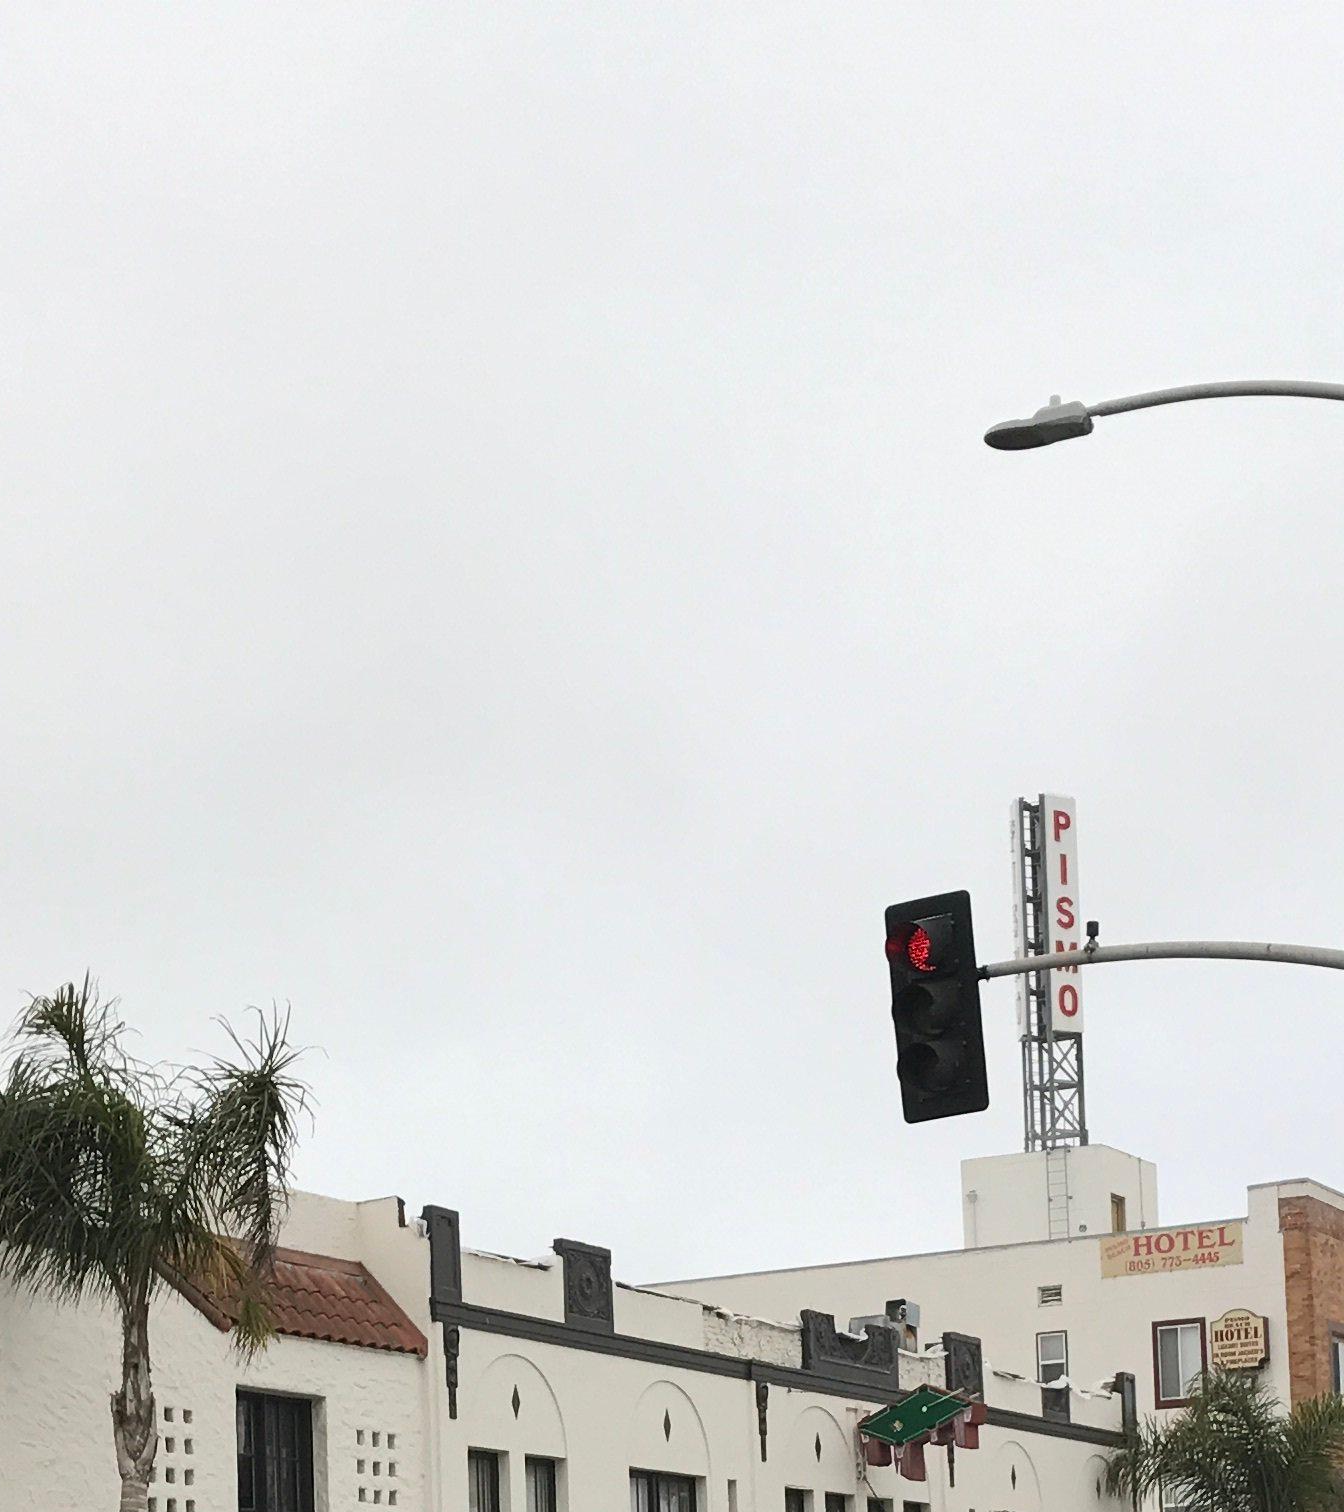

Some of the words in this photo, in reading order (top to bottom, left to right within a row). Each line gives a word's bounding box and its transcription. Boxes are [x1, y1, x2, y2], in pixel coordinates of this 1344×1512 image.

[1053, 809, 1080, 1018] PISMO
[1133, 1227, 1235, 1257] HOTEL
[1125, 1258, 1155, 1272] (805)
[1214, 1326, 1262, 1342] HOTEL
